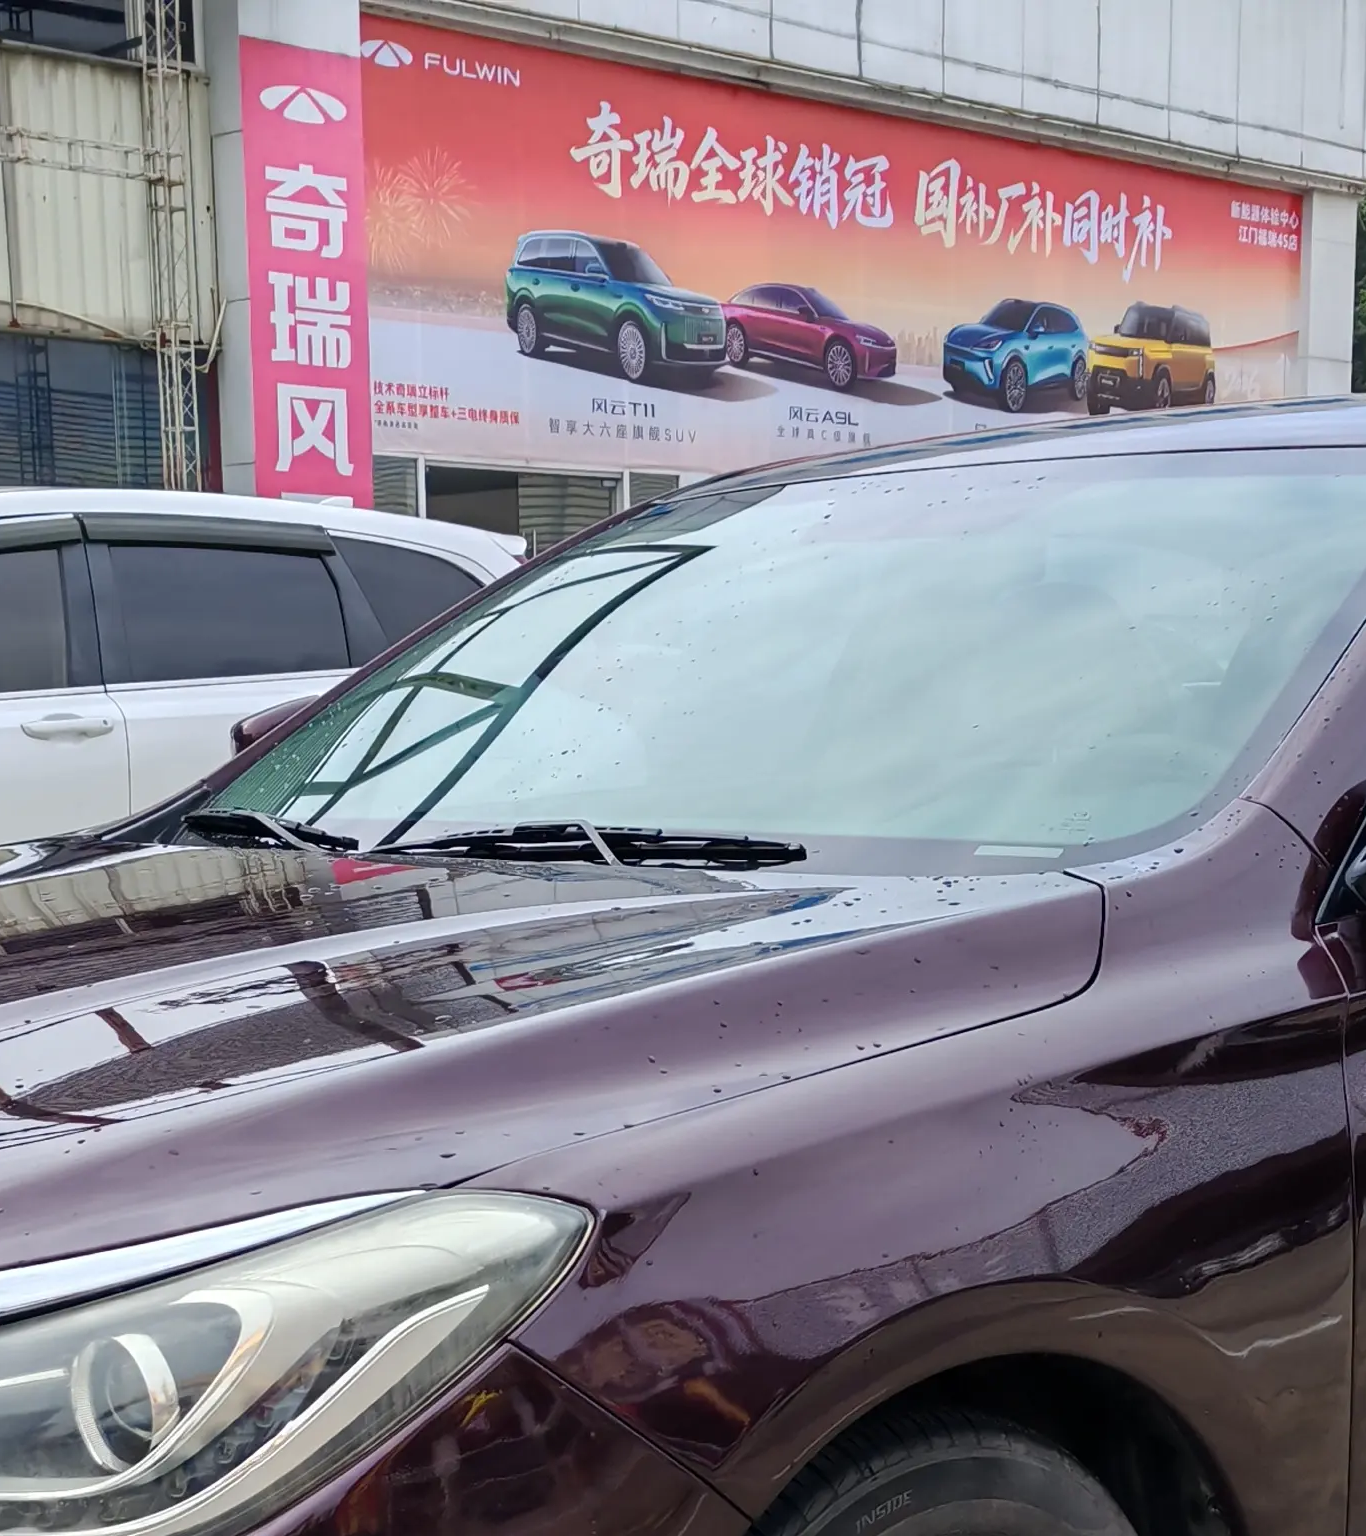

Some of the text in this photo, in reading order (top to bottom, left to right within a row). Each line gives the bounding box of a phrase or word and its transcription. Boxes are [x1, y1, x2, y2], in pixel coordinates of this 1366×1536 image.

[423, 52, 521, 88] FULWIN
[570, 101, 895, 229] 奇瑞全球销冠
[263, 162, 356, 507] 奇瑞风
[591, 397, 656, 419] 风云T11
[788, 405, 860, 427] 风云A9L
